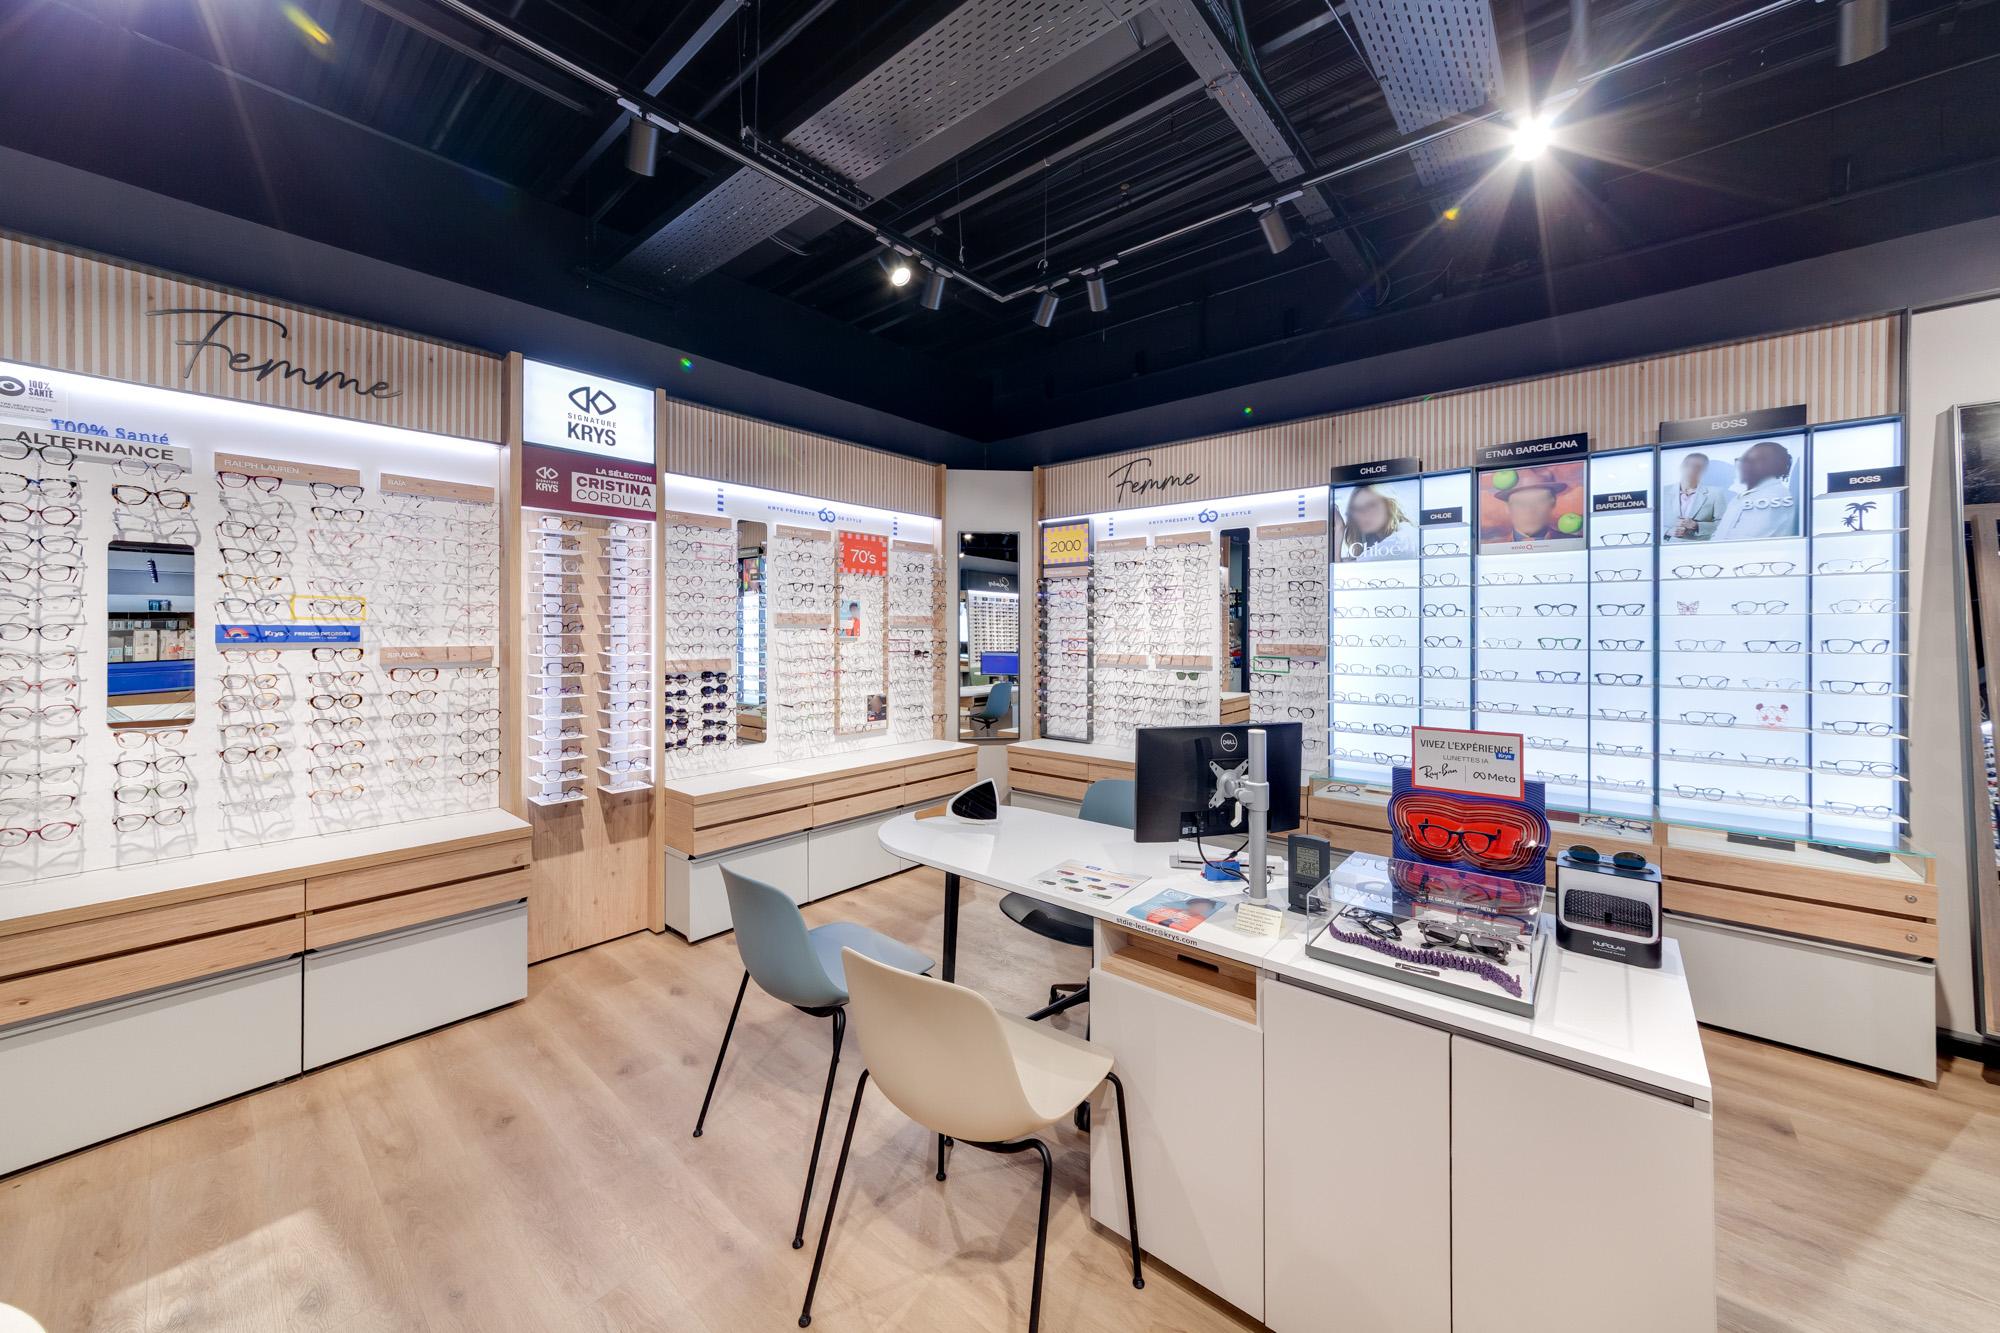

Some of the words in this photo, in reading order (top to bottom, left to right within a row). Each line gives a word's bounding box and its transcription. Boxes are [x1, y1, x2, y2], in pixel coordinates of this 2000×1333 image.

[146, 309, 401, 399] Femme
[29, 380, 50, 390] 100%
[568, 412, 617, 429] SIGNATURE
[1711, 418, 1748, 430] BOSS
[116, 428, 170, 445] Santé
[568, 422, 616, 446] KRYS
[16, 431, 174, 461] ALTERNANCE
[1485, 448, 1513, 460] ETNIA
[1515, 439, 1578, 455] BARCELONA
[224, 460, 258, 469] RALPH
[261, 465, 299, 474] LAUREN
[1360, 465, 1387, 475] CHLOE
[595, 467, 607, 476] LA
[608, 469, 652, 482] SÉLECTION
[1108, 457, 1200, 503] Femme
[1849, 474, 1881, 485] BOSS
[536, 483, 559, 493] KRYS
[576, 476, 652, 497] CRISTINA
[576, 489, 652, 509] CORDULA
[1608, 493, 1632, 502] ETNIA
[1743, 497, 1793, 511] BOSS
[1595, 500, 1645, 511] BARCELONA
[1430, 511, 1452, 520] CHLOE
[1050, 540, 1081, 553] 2000
[851, 549, 877, 564] 70's
[265, 630, 284, 638] Krys
[1420, 739, 1446, 749] VIVEZ
[1448, 741, 1513, 754] L'EXPÉRIENCE
[1443, 754, 1480, 764] LUNETTES
[1419, 763, 1458, 780] Ray-Ban
[1488, 773, 1516, 783] Meta
